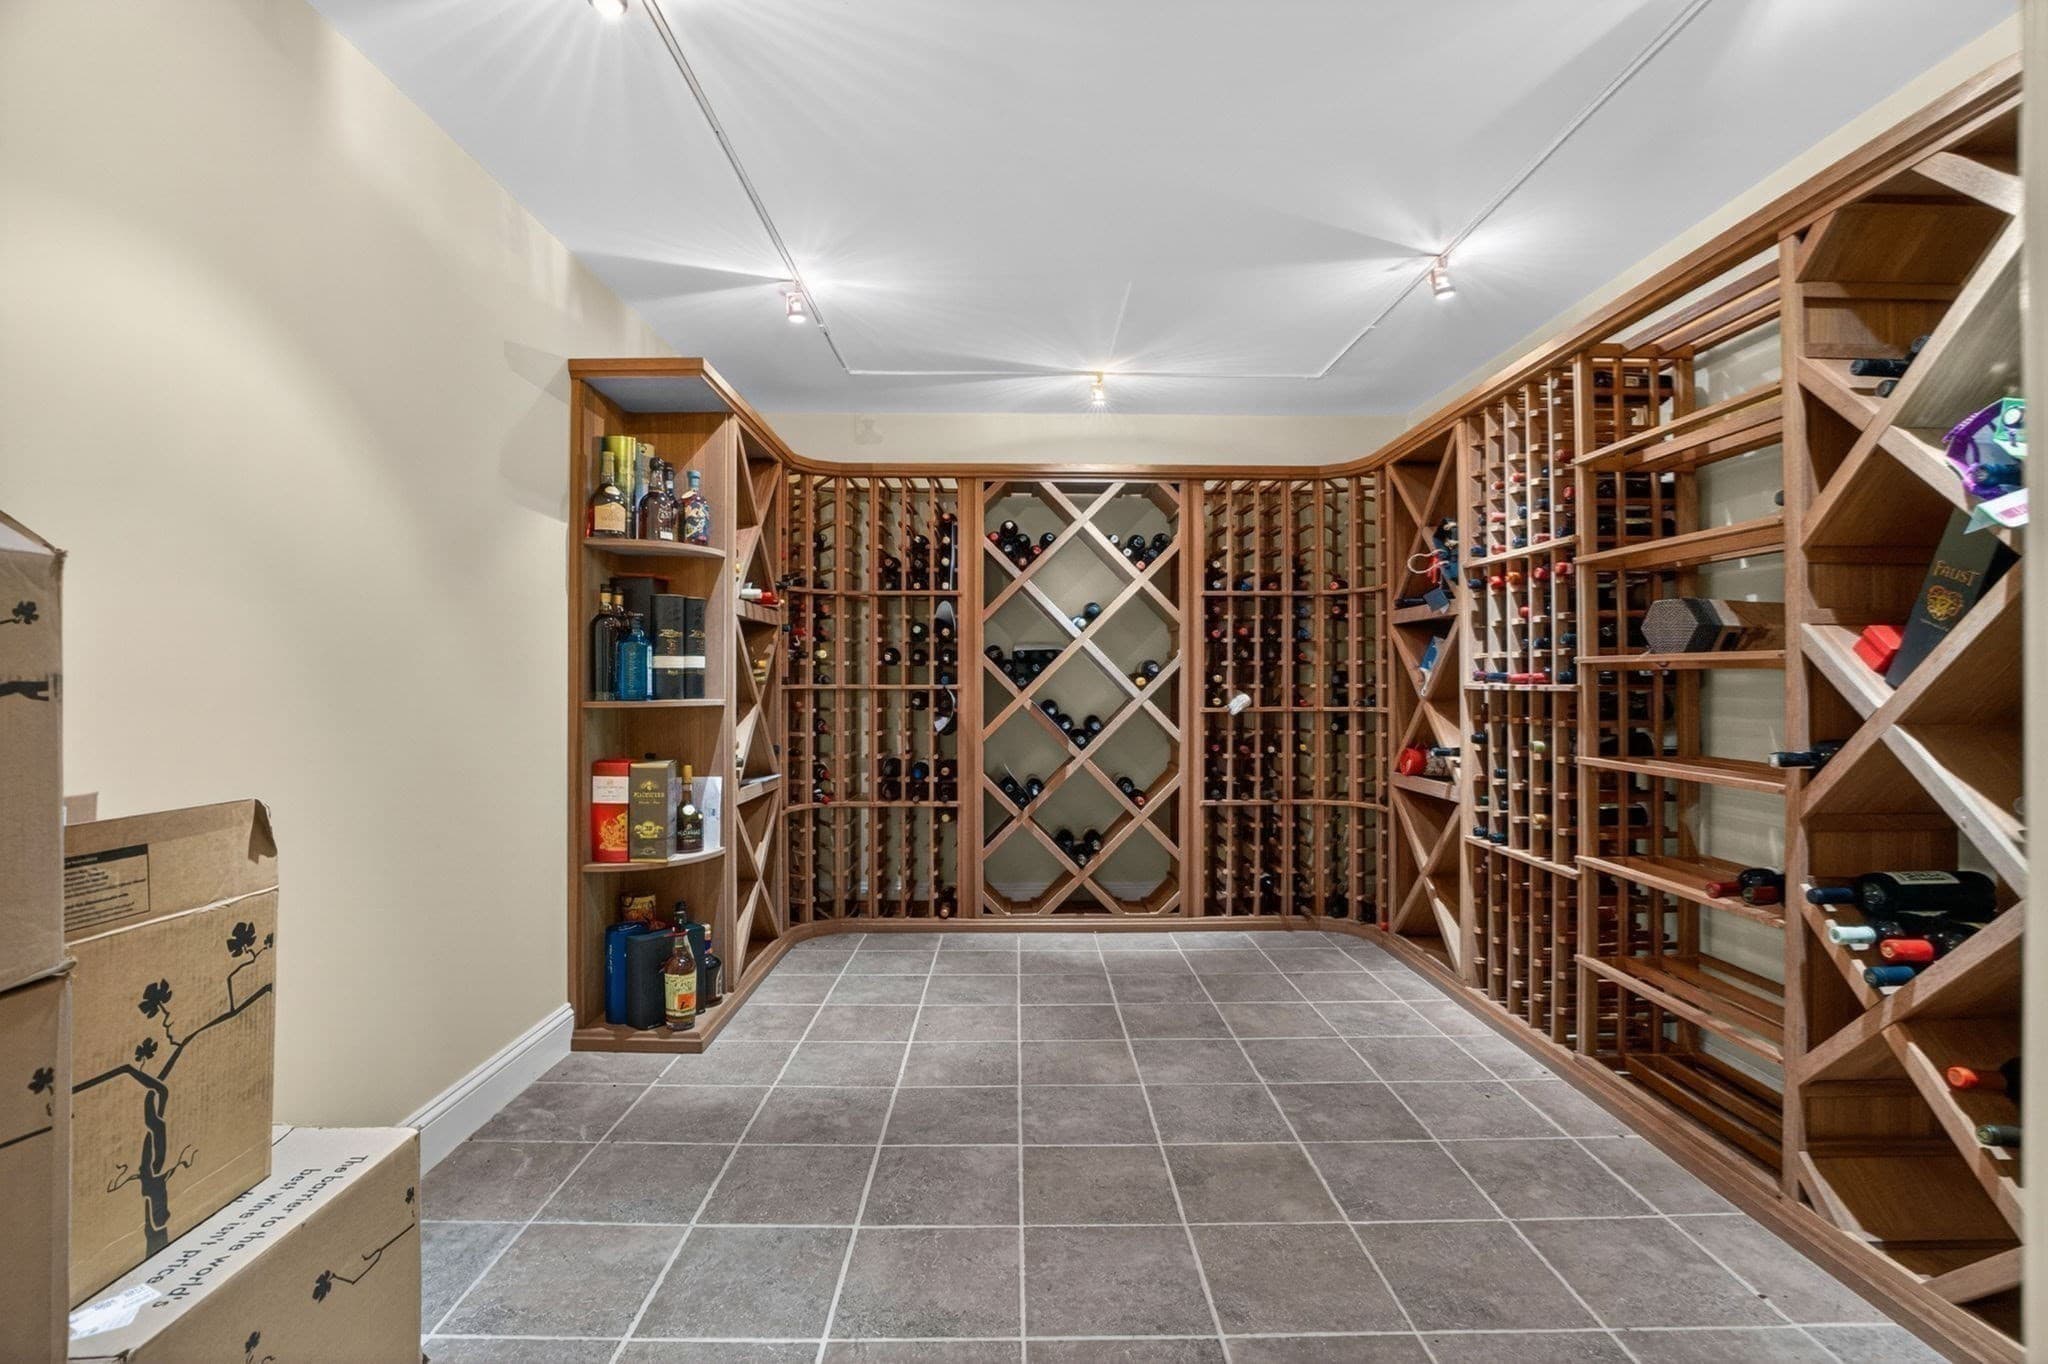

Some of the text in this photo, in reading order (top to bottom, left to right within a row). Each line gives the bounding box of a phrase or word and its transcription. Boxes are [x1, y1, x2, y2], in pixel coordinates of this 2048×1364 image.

[334, 1154, 368, 1173] The
[284, 1168, 322, 1190] best
[283, 1174, 343, 1213] barrier
[239, 1193, 282, 1219] wine
[261, 1215, 286, 1228] to
[200, 1222, 245, 1246] isn't
[229, 1231, 266, 1251] the
[146, 1250, 200, 1284] price
[152, 1255, 231, 1308] world's
